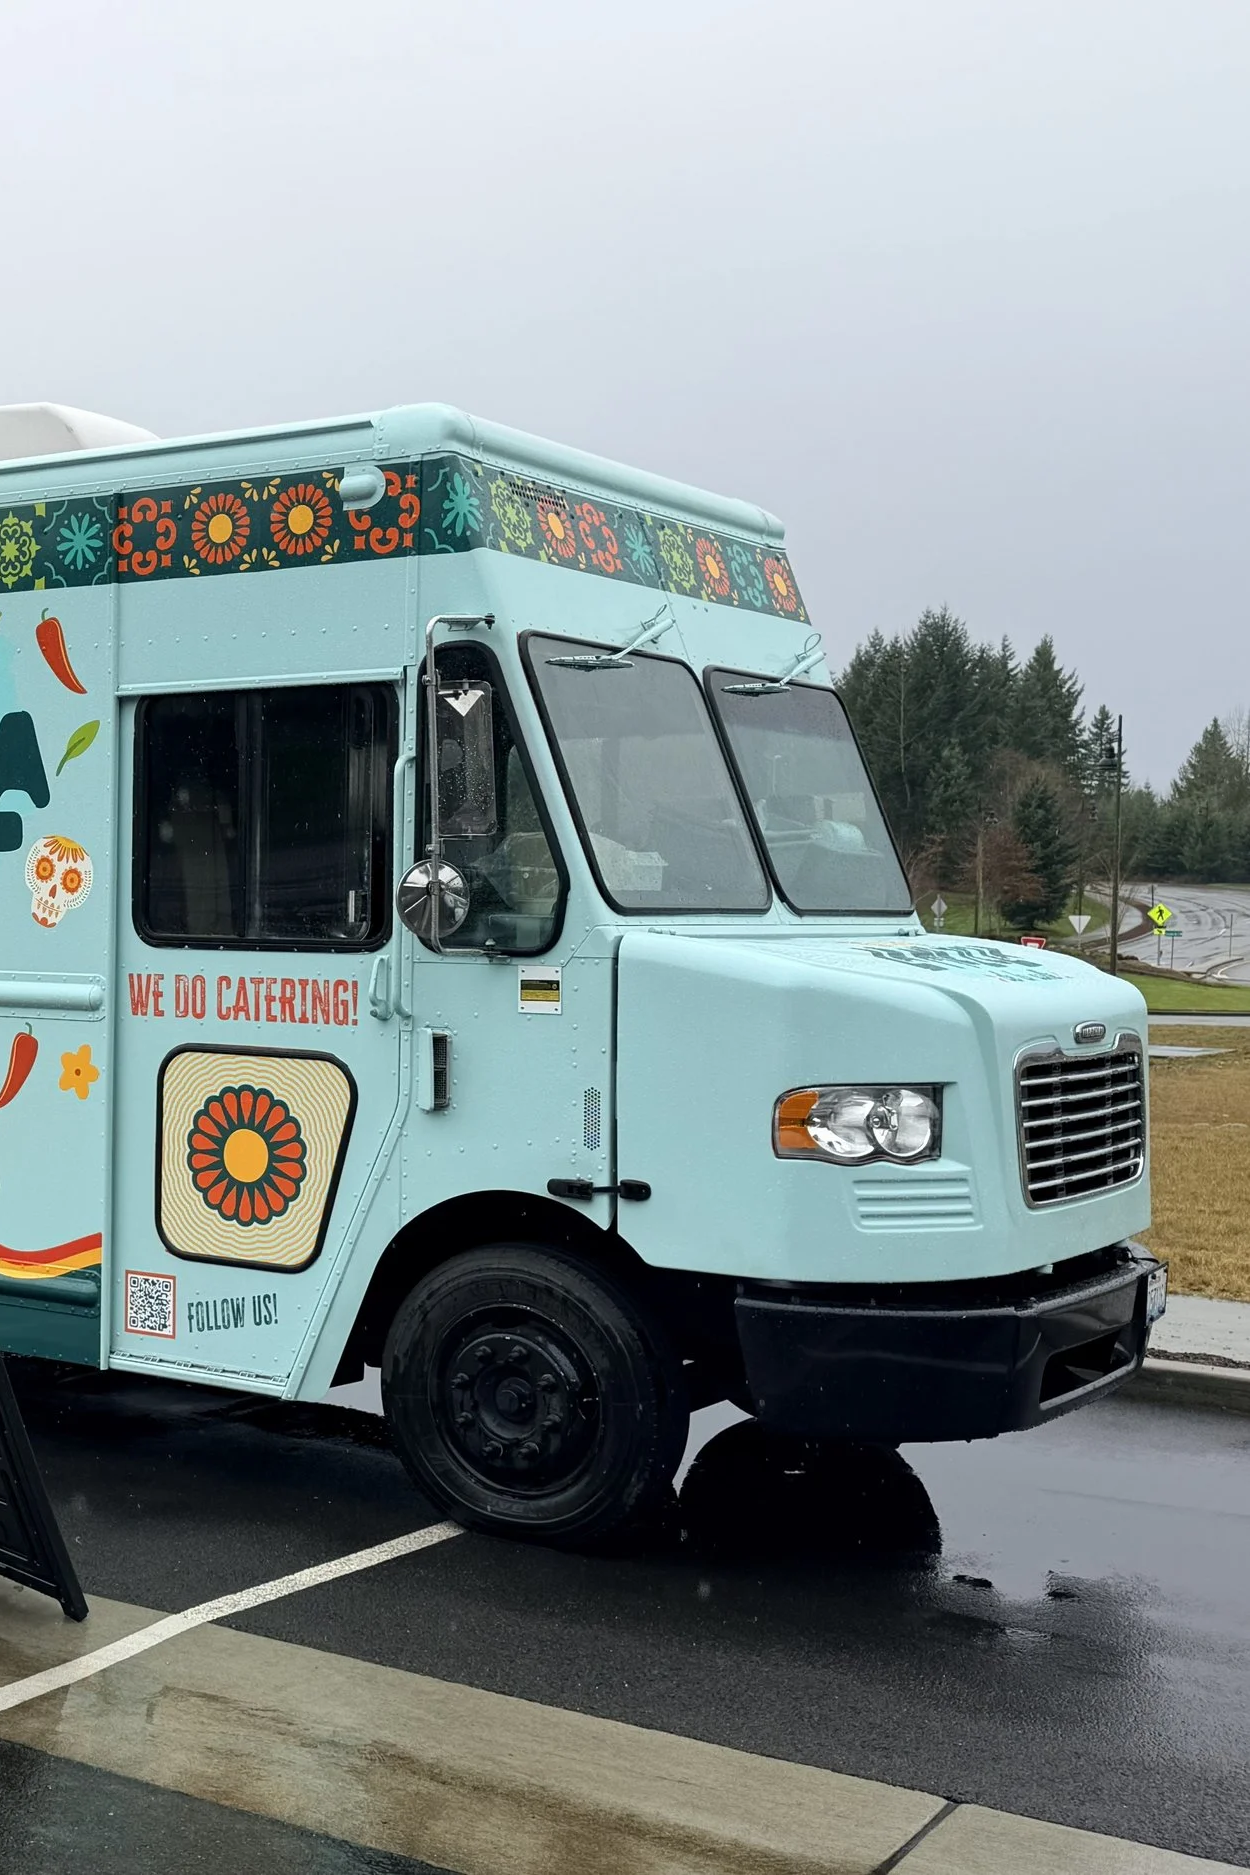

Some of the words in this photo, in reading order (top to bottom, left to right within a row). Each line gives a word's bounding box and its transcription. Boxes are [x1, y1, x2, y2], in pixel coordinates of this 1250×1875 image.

[128, 973, 165, 1018] WE
[174, 974, 207, 1020] DO
[216, 975, 359, 1027] CATERING!
[187, 1297, 246, 1333] FOLLOW
[252, 1293, 279, 1326] US!
